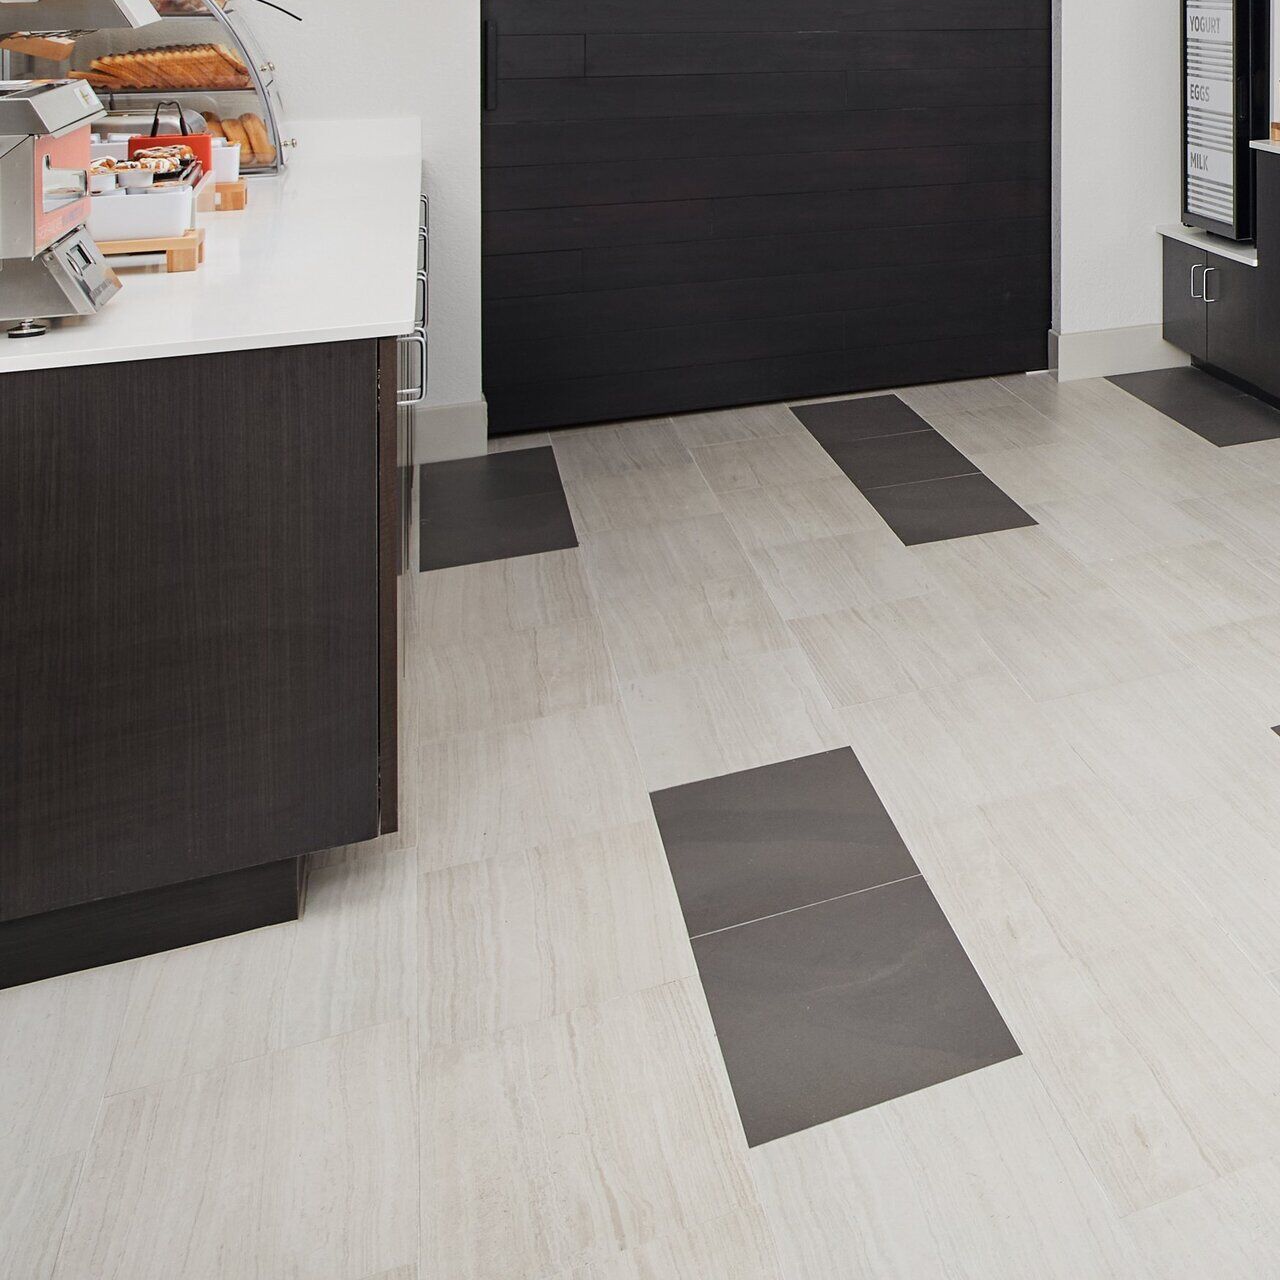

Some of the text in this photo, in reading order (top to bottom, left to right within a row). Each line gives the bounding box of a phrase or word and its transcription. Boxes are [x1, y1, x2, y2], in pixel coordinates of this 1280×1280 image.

[1189, 15, 1221, 34] YOGURT
[1190, 84, 1210, 102] EGGS
[1190, 151, 1209, 172] MILK
